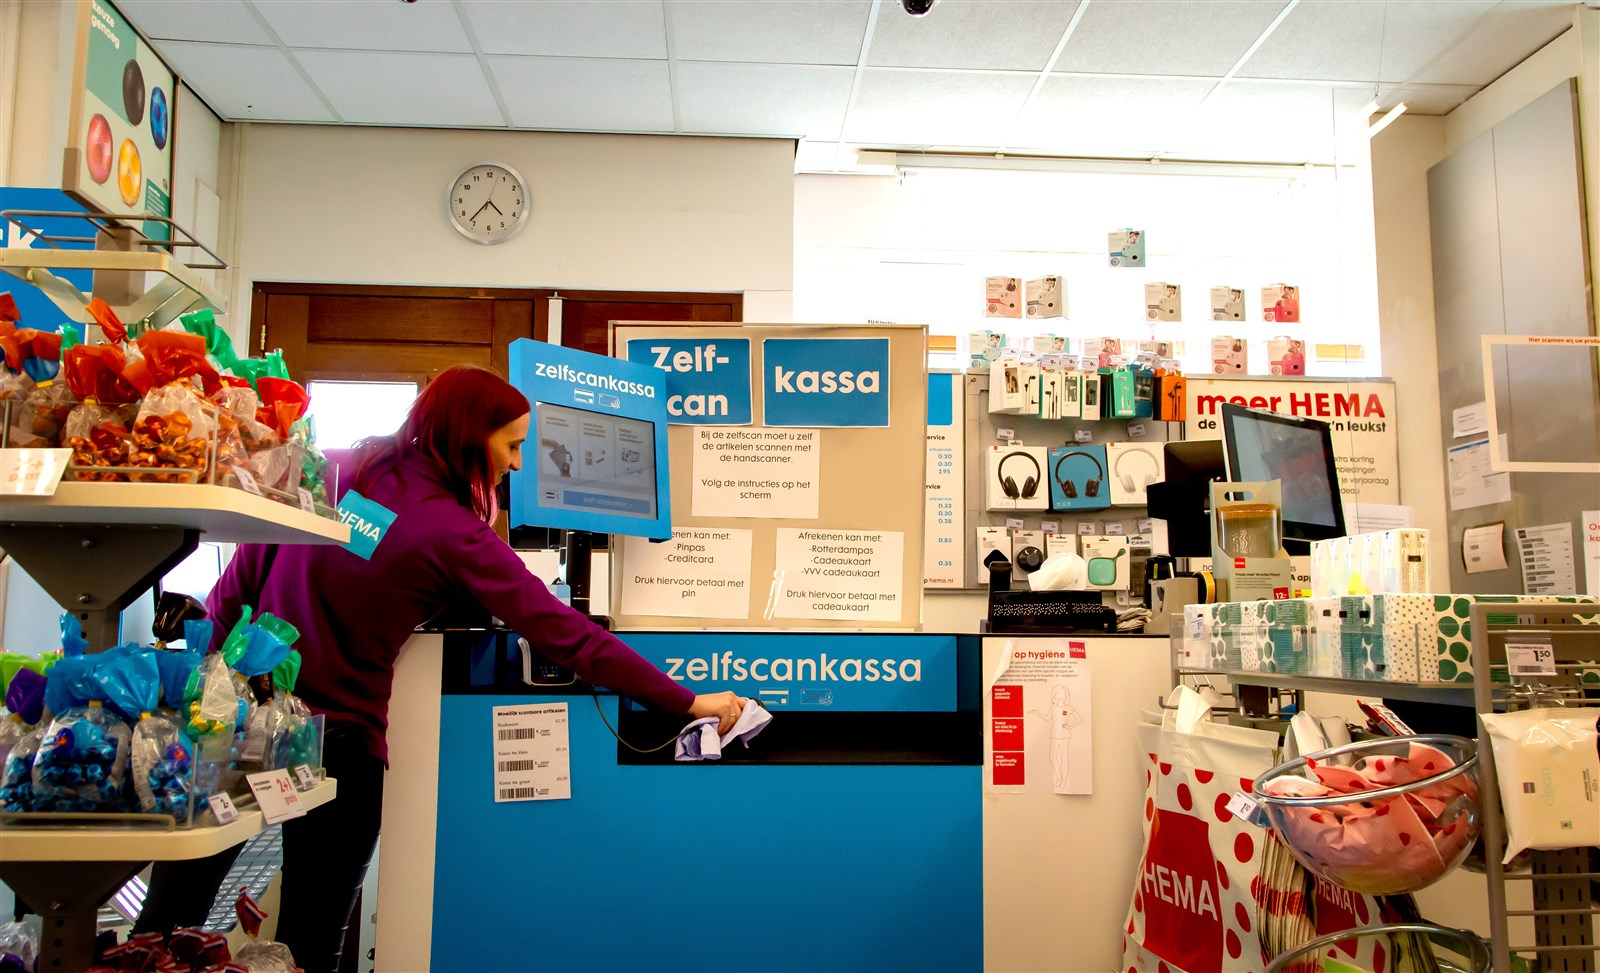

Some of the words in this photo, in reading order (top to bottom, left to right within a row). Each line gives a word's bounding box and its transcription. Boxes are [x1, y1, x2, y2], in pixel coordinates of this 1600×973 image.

[92, 0, 115, 28] keuze
[92, 15, 119, 49] genoeg
[651, 344, 730, 373] Zelf-
[535, 362, 655, 398] zelfscankassa
[775, 365, 880, 394] kassa
[667, 394, 728, 416] can
[1290, 392, 1386, 418] HEMA
[1198, 419, 1217, 430] de
[1348, 420, 1387, 433] leukst
[701, 431, 711, 440] Bij
[712, 431, 724, 439] de
[726, 431, 762, 440] zelfscan
[764, 432, 787, 440] moet
[797, 432, 813, 440] zelf
[702, 442, 714, 450] de
[716, 443, 754, 451] artikelen
[794, 444, 811, 452] met
[720, 454, 732, 462] de
[734, 454, 793, 463] handscanner.
[1350, 456, 1375, 464] korting
[702, 479, 722, 488] Volg
[724, 480, 736, 488] de
[738, 480, 780, 488] instructies
[782, 482, 794, 490] op
[797, 481, 811, 489] het
[1341, 477, 1348, 485] je
[1350, 477, 1389, 486] verjaardag
[740, 491, 772, 499] scherm
[338, 507, 381, 542] HEMA
[694, 531, 710, 539] kan
[712, 532, 731, 540] met:
[798, 532, 843, 541] Afrekenen
[845, 533, 862, 542] kan
[864, 534, 883, 542] met:
[674, 543, 705, 553] -Pinpas
[809, 545, 873, 556] -Rotterdampas
[664, 554, 714, 564] -Creditcard
[810, 556, 871, 566] -Cadeaukaart
[823, 568, 880, 578] cadeaukaart
[635, 576, 654, 584] Druk
[656, 576, 695, 586] hiervoor
[696, 578, 725, 587] betaal
[727, 579, 744, 588] met
[682, 589, 696, 598] pin
[787, 590, 806, 599] Druk
[808, 590, 846, 599] hiervoor
[848, 592, 877, 600] betaal
[879, 593, 896, 601] met
[812, 602, 870, 612] cadeaukaart
[666, 651, 922, 682] zelfscankassa
[276, 777, 292, 793] 2+1
[1143, 862, 1218, 922] HEMA
[1317, 874, 1354, 915] HEMA
